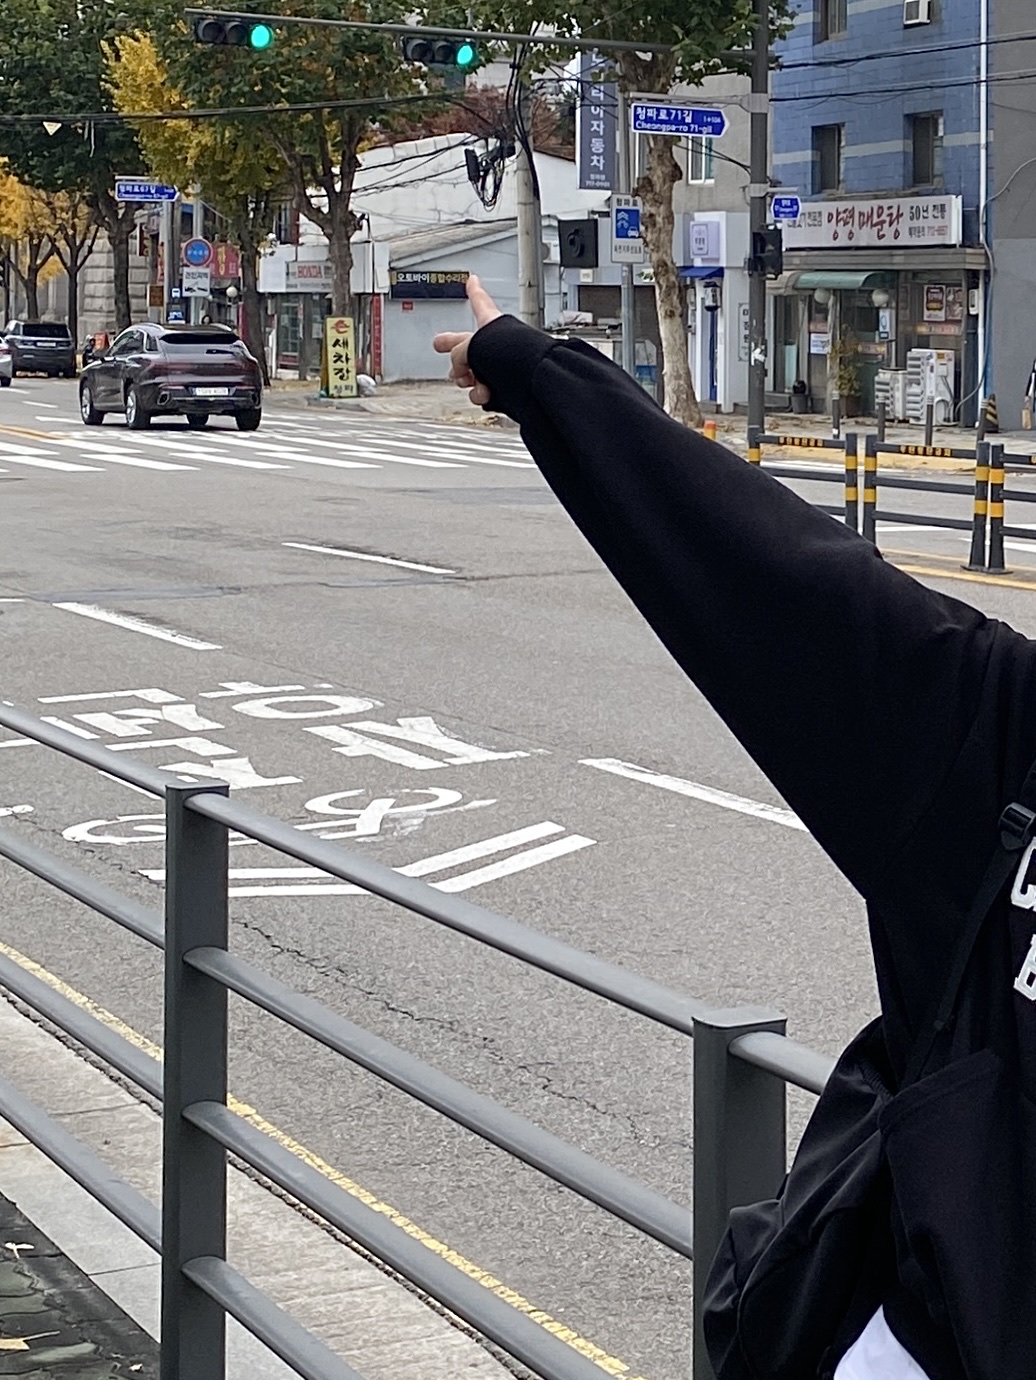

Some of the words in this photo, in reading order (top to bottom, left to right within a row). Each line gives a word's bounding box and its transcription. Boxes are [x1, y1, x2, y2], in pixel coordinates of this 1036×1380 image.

[635, 107, 693, 123] 청파로71길
[635, 121, 689, 133] Cheongpa-ro
[909, 204, 929, 221] 50년
[332, 337, 351, 380] 세차장
